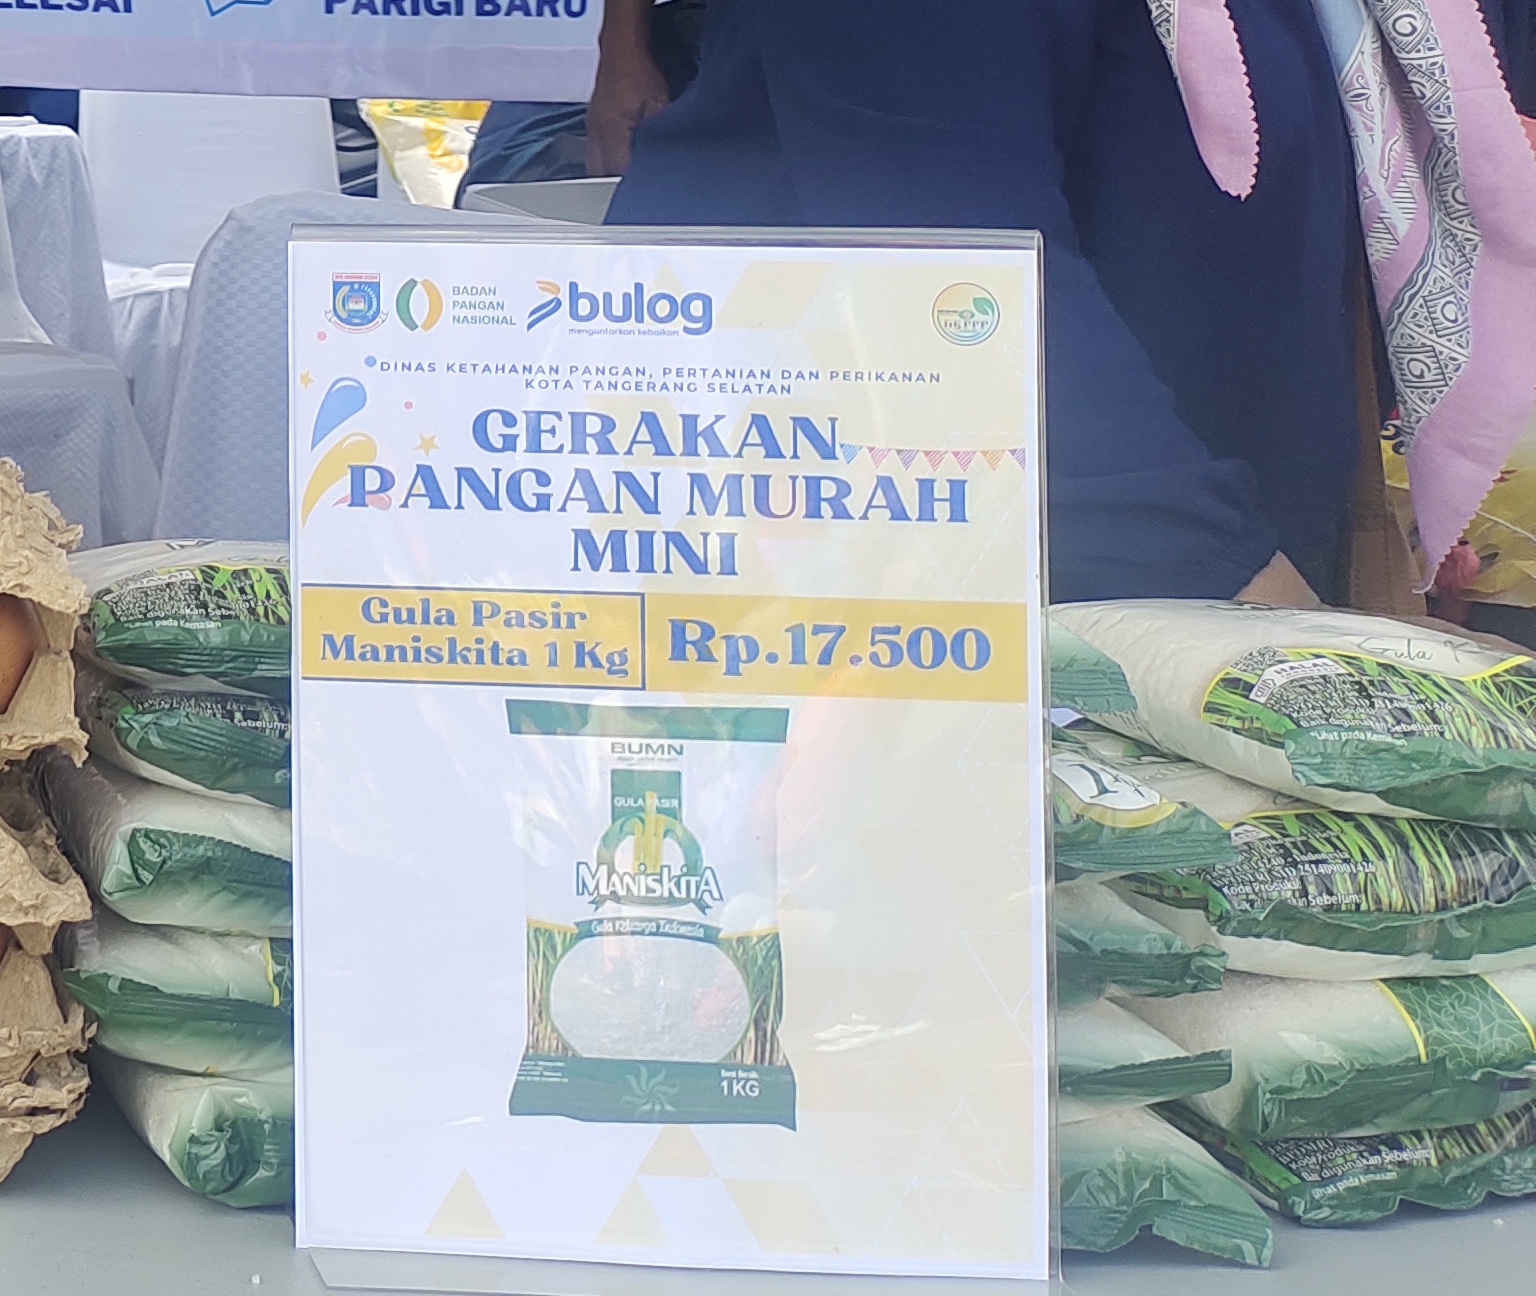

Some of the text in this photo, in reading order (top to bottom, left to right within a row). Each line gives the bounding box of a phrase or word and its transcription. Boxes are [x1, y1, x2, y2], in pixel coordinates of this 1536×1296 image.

[451, 285, 497, 297] BADAN
[451, 299, 506, 312] PANGAN
[568, 281, 714, 336] bulog
[451, 313, 518, 326] NASIONAL
[568, 327, 679, 337] mengantarkan kebaikan
[380, 360, 941, 384] DINAS KETAHANAN PANGAN, PERTANIAN DAN PERIKANAN
[524, 378, 792, 396] KOTA TANGERANG SELATAN
[471, 406, 840, 461] GERAKAN
[347, 463, 969, 524] PANGAN MURAH
[569, 527, 739, 577] MINI
[360, 595, 588, 630] Gula Pasir
[320, 632, 630, 679] Maniskita 1 Kg
[667, 617, 993, 677] Rp.17.500
[1273, 659, 1336, 675] HALAL
[610, 741, 685, 756] BUMN
[613, 796, 645, 808] GULA
[720, 1079, 760, 1097] 1 KG
